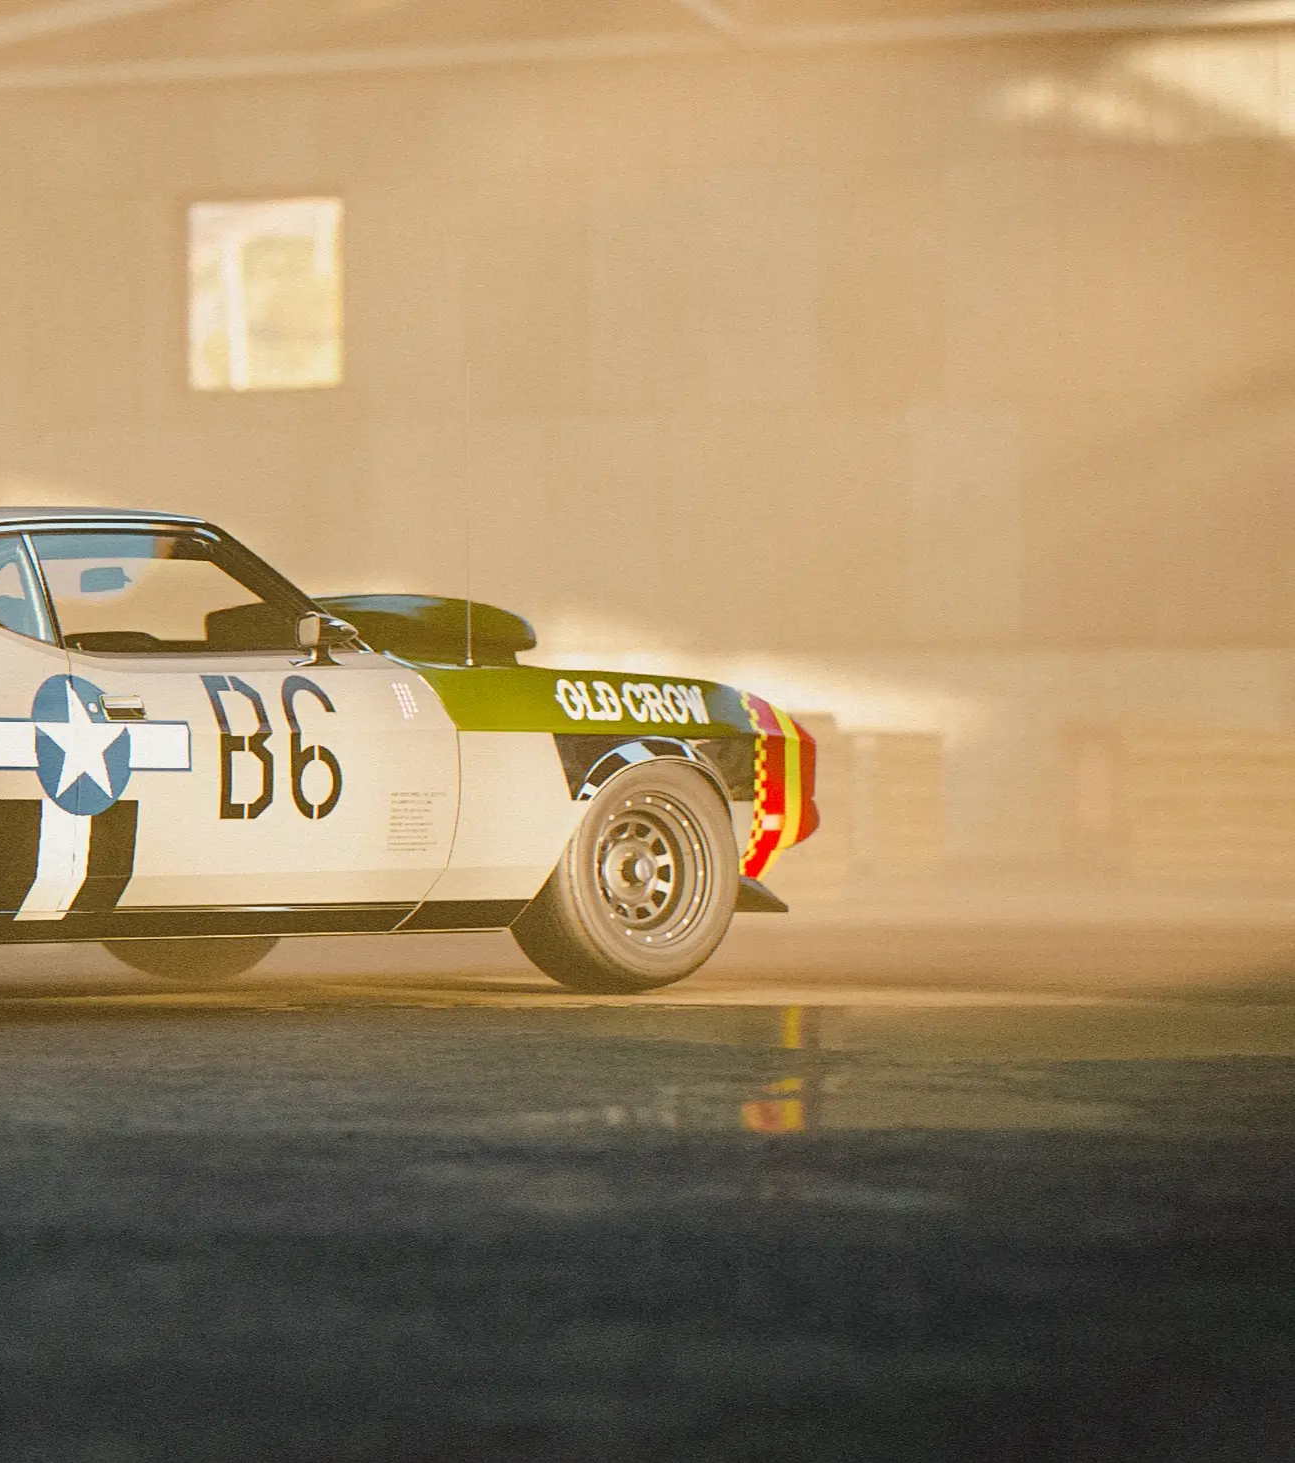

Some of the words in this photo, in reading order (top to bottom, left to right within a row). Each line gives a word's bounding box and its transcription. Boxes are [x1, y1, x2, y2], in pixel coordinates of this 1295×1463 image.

[199, 675, 343, 820] B6
[554, 678, 624, 721] OLD
[621, 681, 711, 725] CROW
